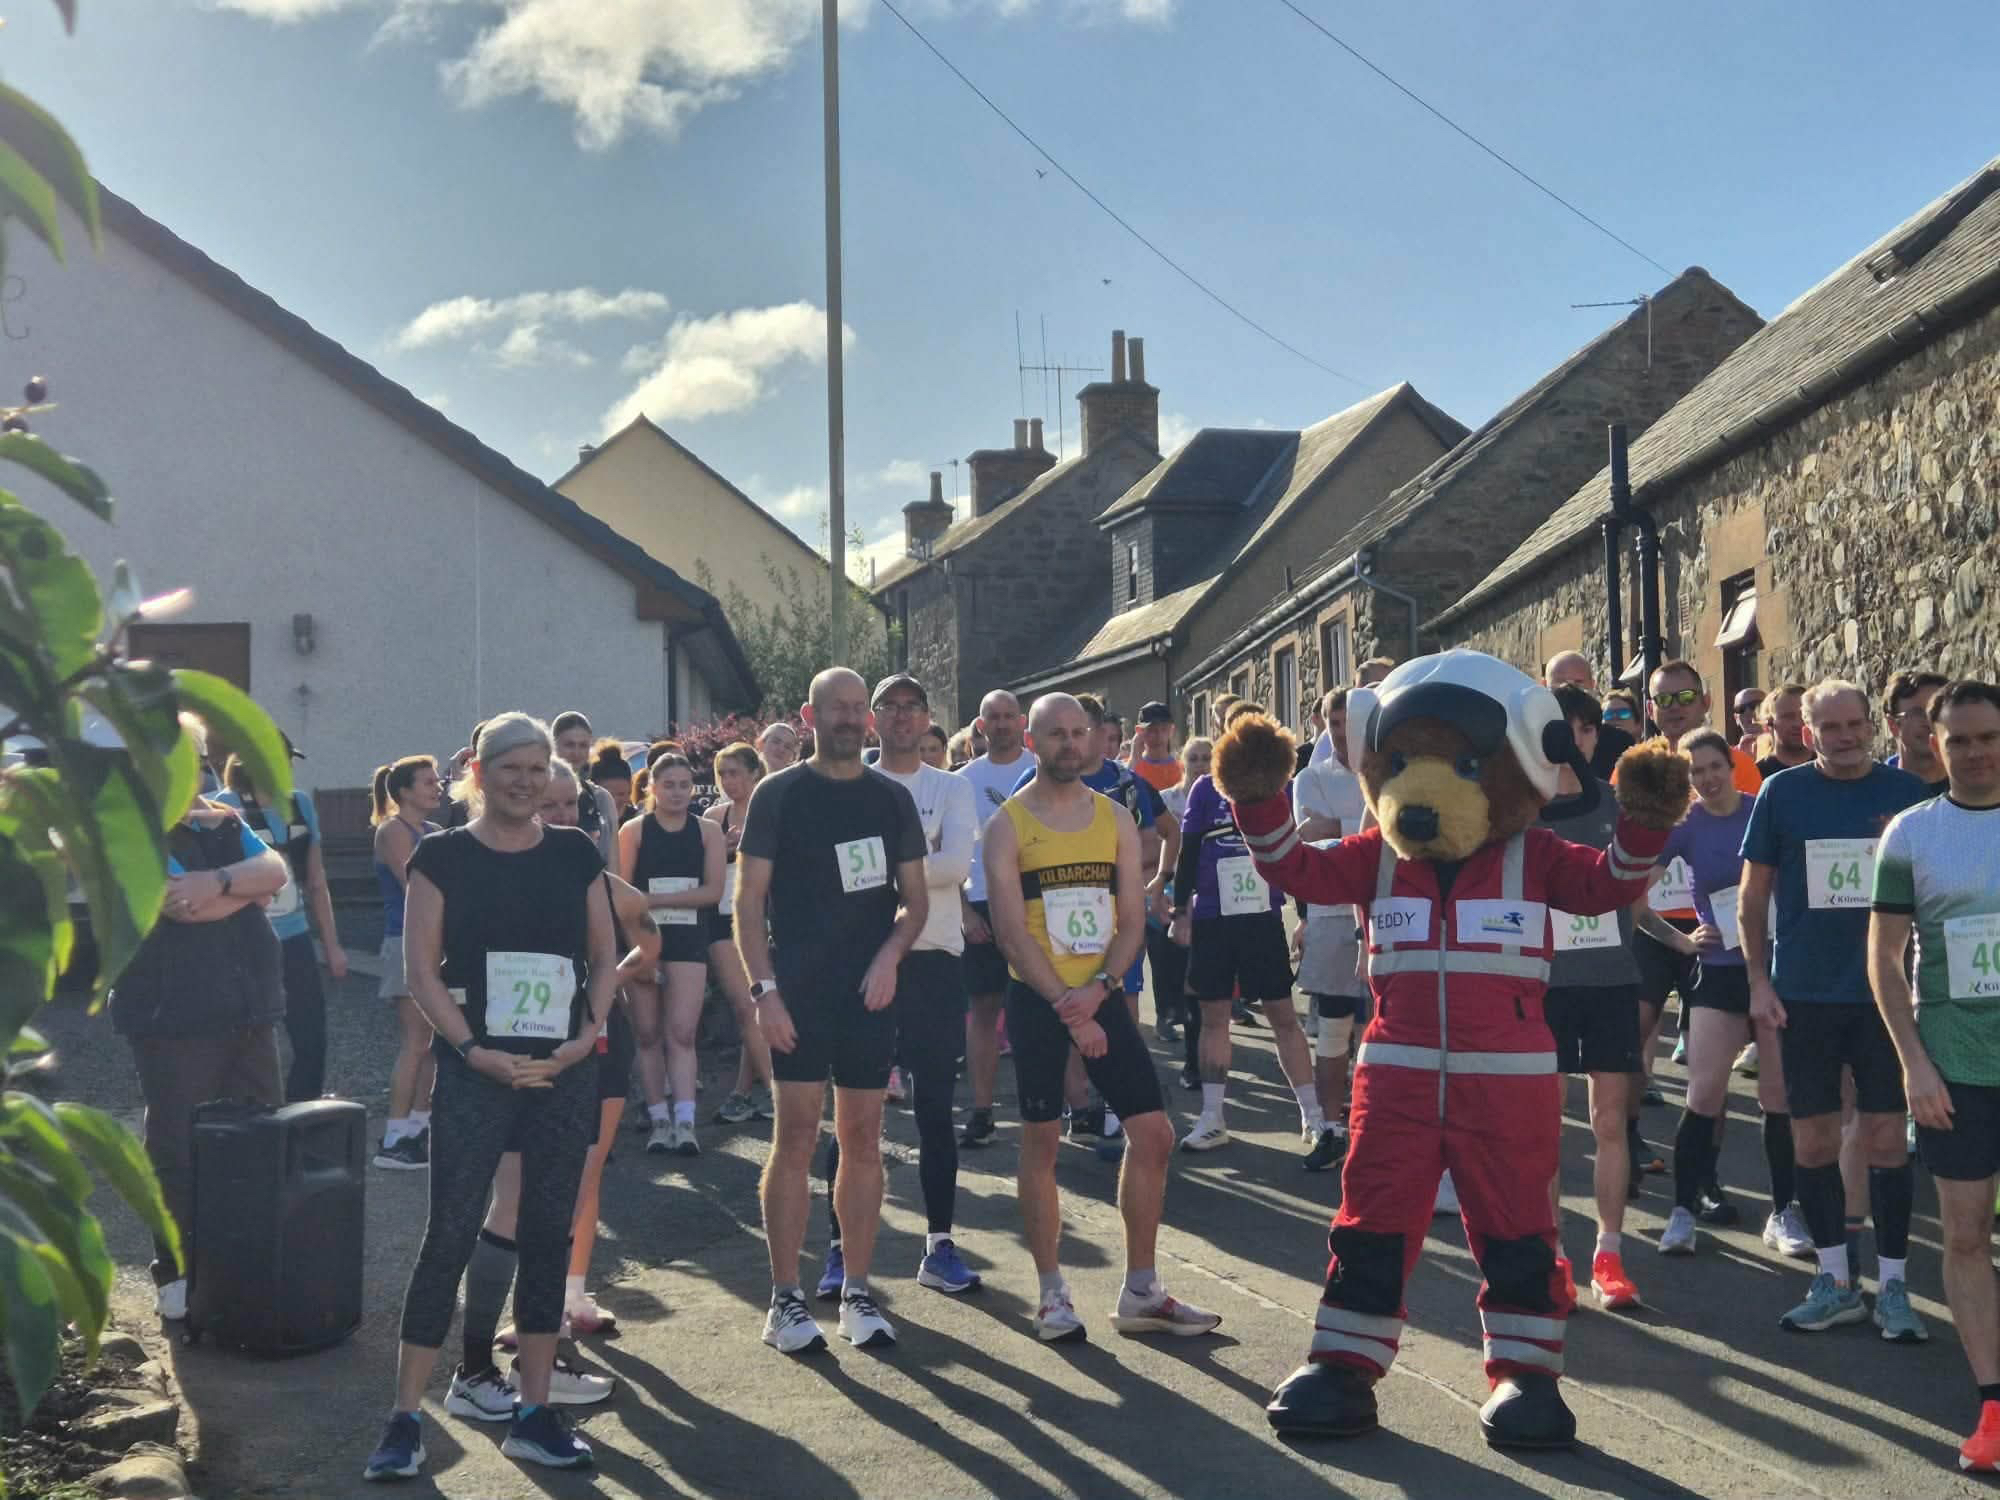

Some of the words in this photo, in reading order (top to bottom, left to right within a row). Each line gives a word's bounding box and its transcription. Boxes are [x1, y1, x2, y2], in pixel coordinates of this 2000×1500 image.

[848, 841, 876, 872] 51
[1232, 871, 1256, 893] 36
[1828, 861, 1862, 891] 64
[1067, 910, 1098, 937] 63
[512, 980, 551, 1015] 29
